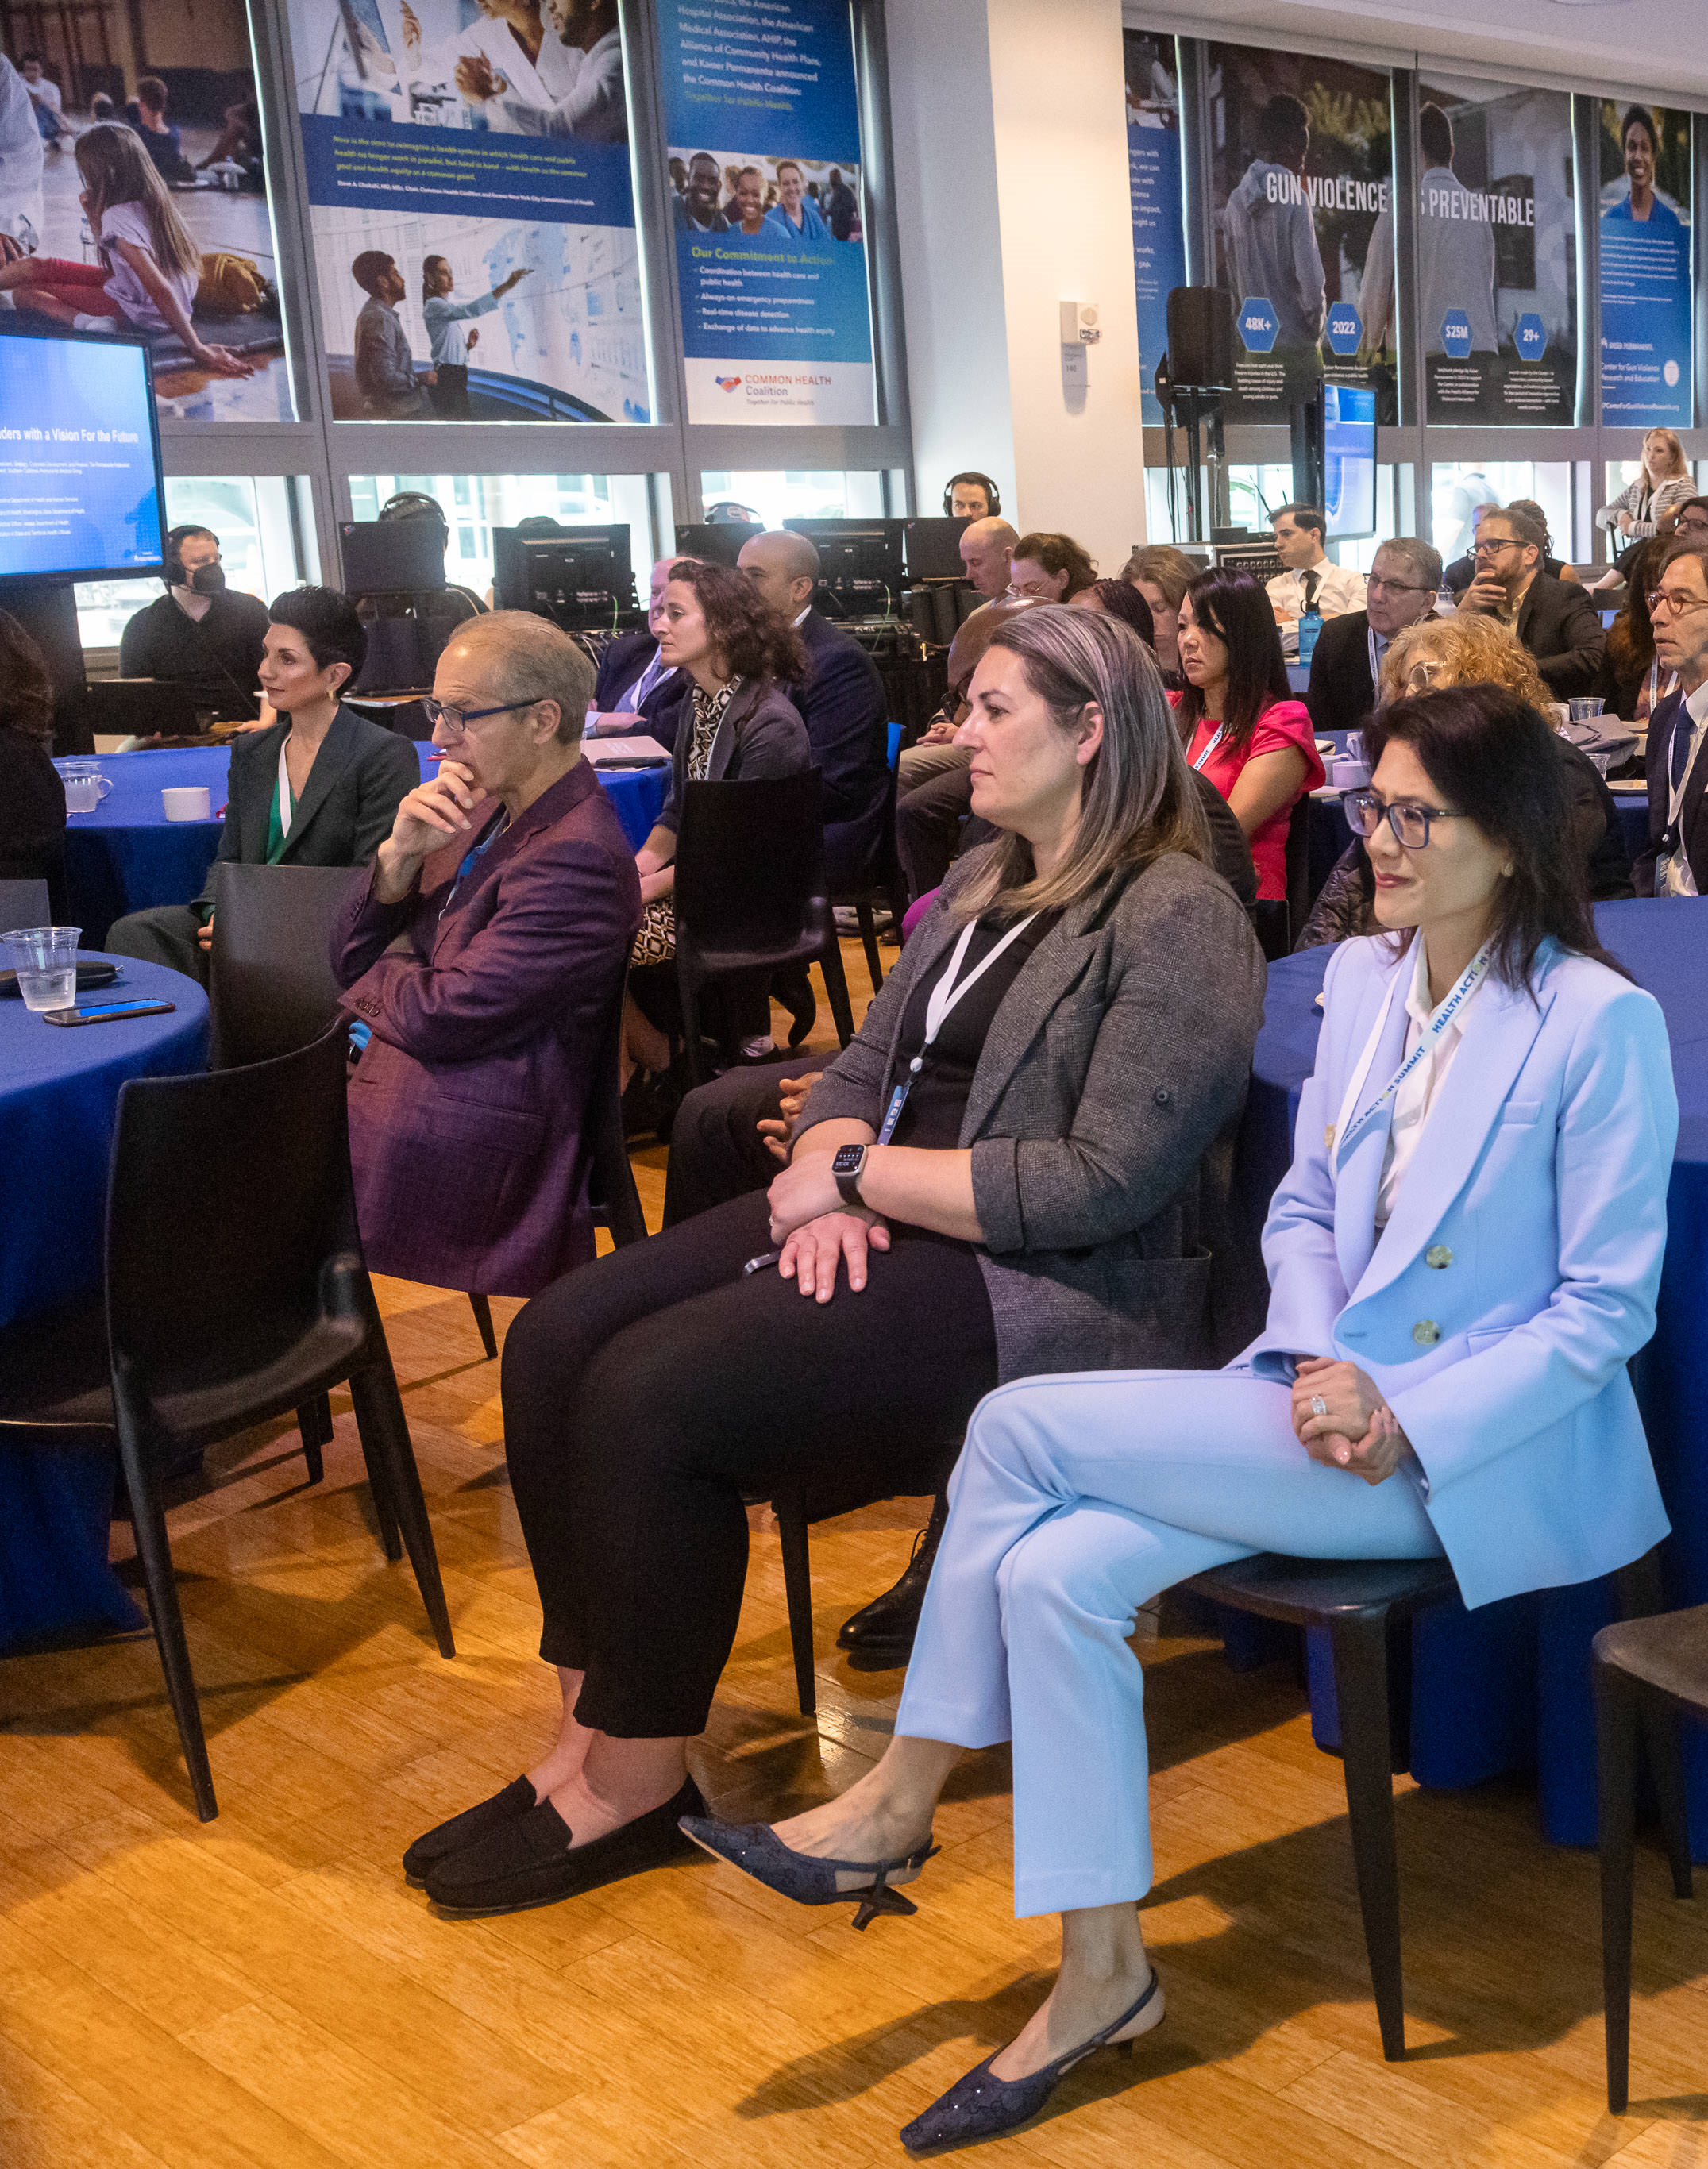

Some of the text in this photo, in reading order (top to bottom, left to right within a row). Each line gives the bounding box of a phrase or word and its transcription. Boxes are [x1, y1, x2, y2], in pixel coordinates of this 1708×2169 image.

[678, 6, 711, 18] Hospital
[761, 17, 775, 27] the
[776, 20, 813, 33] American
[679, 22, 711, 35] Medical
[784, 37, 797, 47] the
[681, 40, 713, 52] Alliance
[715, 44, 723, 53] of
[724, 45, 770, 62] Community
[771, 51, 798, 63] Health
[682, 57, 818, 82] and Kaiser Permanente announced
[683, 73, 697, 83] the
[698, 74, 735, 88] Common
[736, 80, 764, 91] Health
[1267, 171, 1301, 206] GUN
[1307, 176, 1388, 213] VIOLENCE
[1429, 188, 1534, 227] PREVENTABLE
[692, 246, 833, 265] Our Commitment to Action
[699, 265, 742, 275] Coordination
[742, 268, 771, 277] between
[700, 278, 722, 287] public
[736, 296, 771, 305] emergency
[702, 307, 734, 316] Real-time
[734, 309, 759, 318] disease
[703, 322, 735, 333] Exchange
[1245, 316, 1271, 331] 48K+
[1332, 320, 1355, 335] 2022
[1445, 326, 1468, 339] $25M
[1523, 329, 1540, 342] 29+
[1625, 363, 1637, 372] Gun
[745, 375, 832, 385] COMMON HEALTH
[746, 386, 788, 396] Coalition
[0, 426, 138, 443] ders with a Vision For the Future
[1195, 750, 1209, 769] SUMMIT
[1432, 956, 1487, 1034] HEALTH ACTION
[1364, 1085, 1395, 1117] ACTION
[1394, 1045, 1425, 1085] SUMMIT
